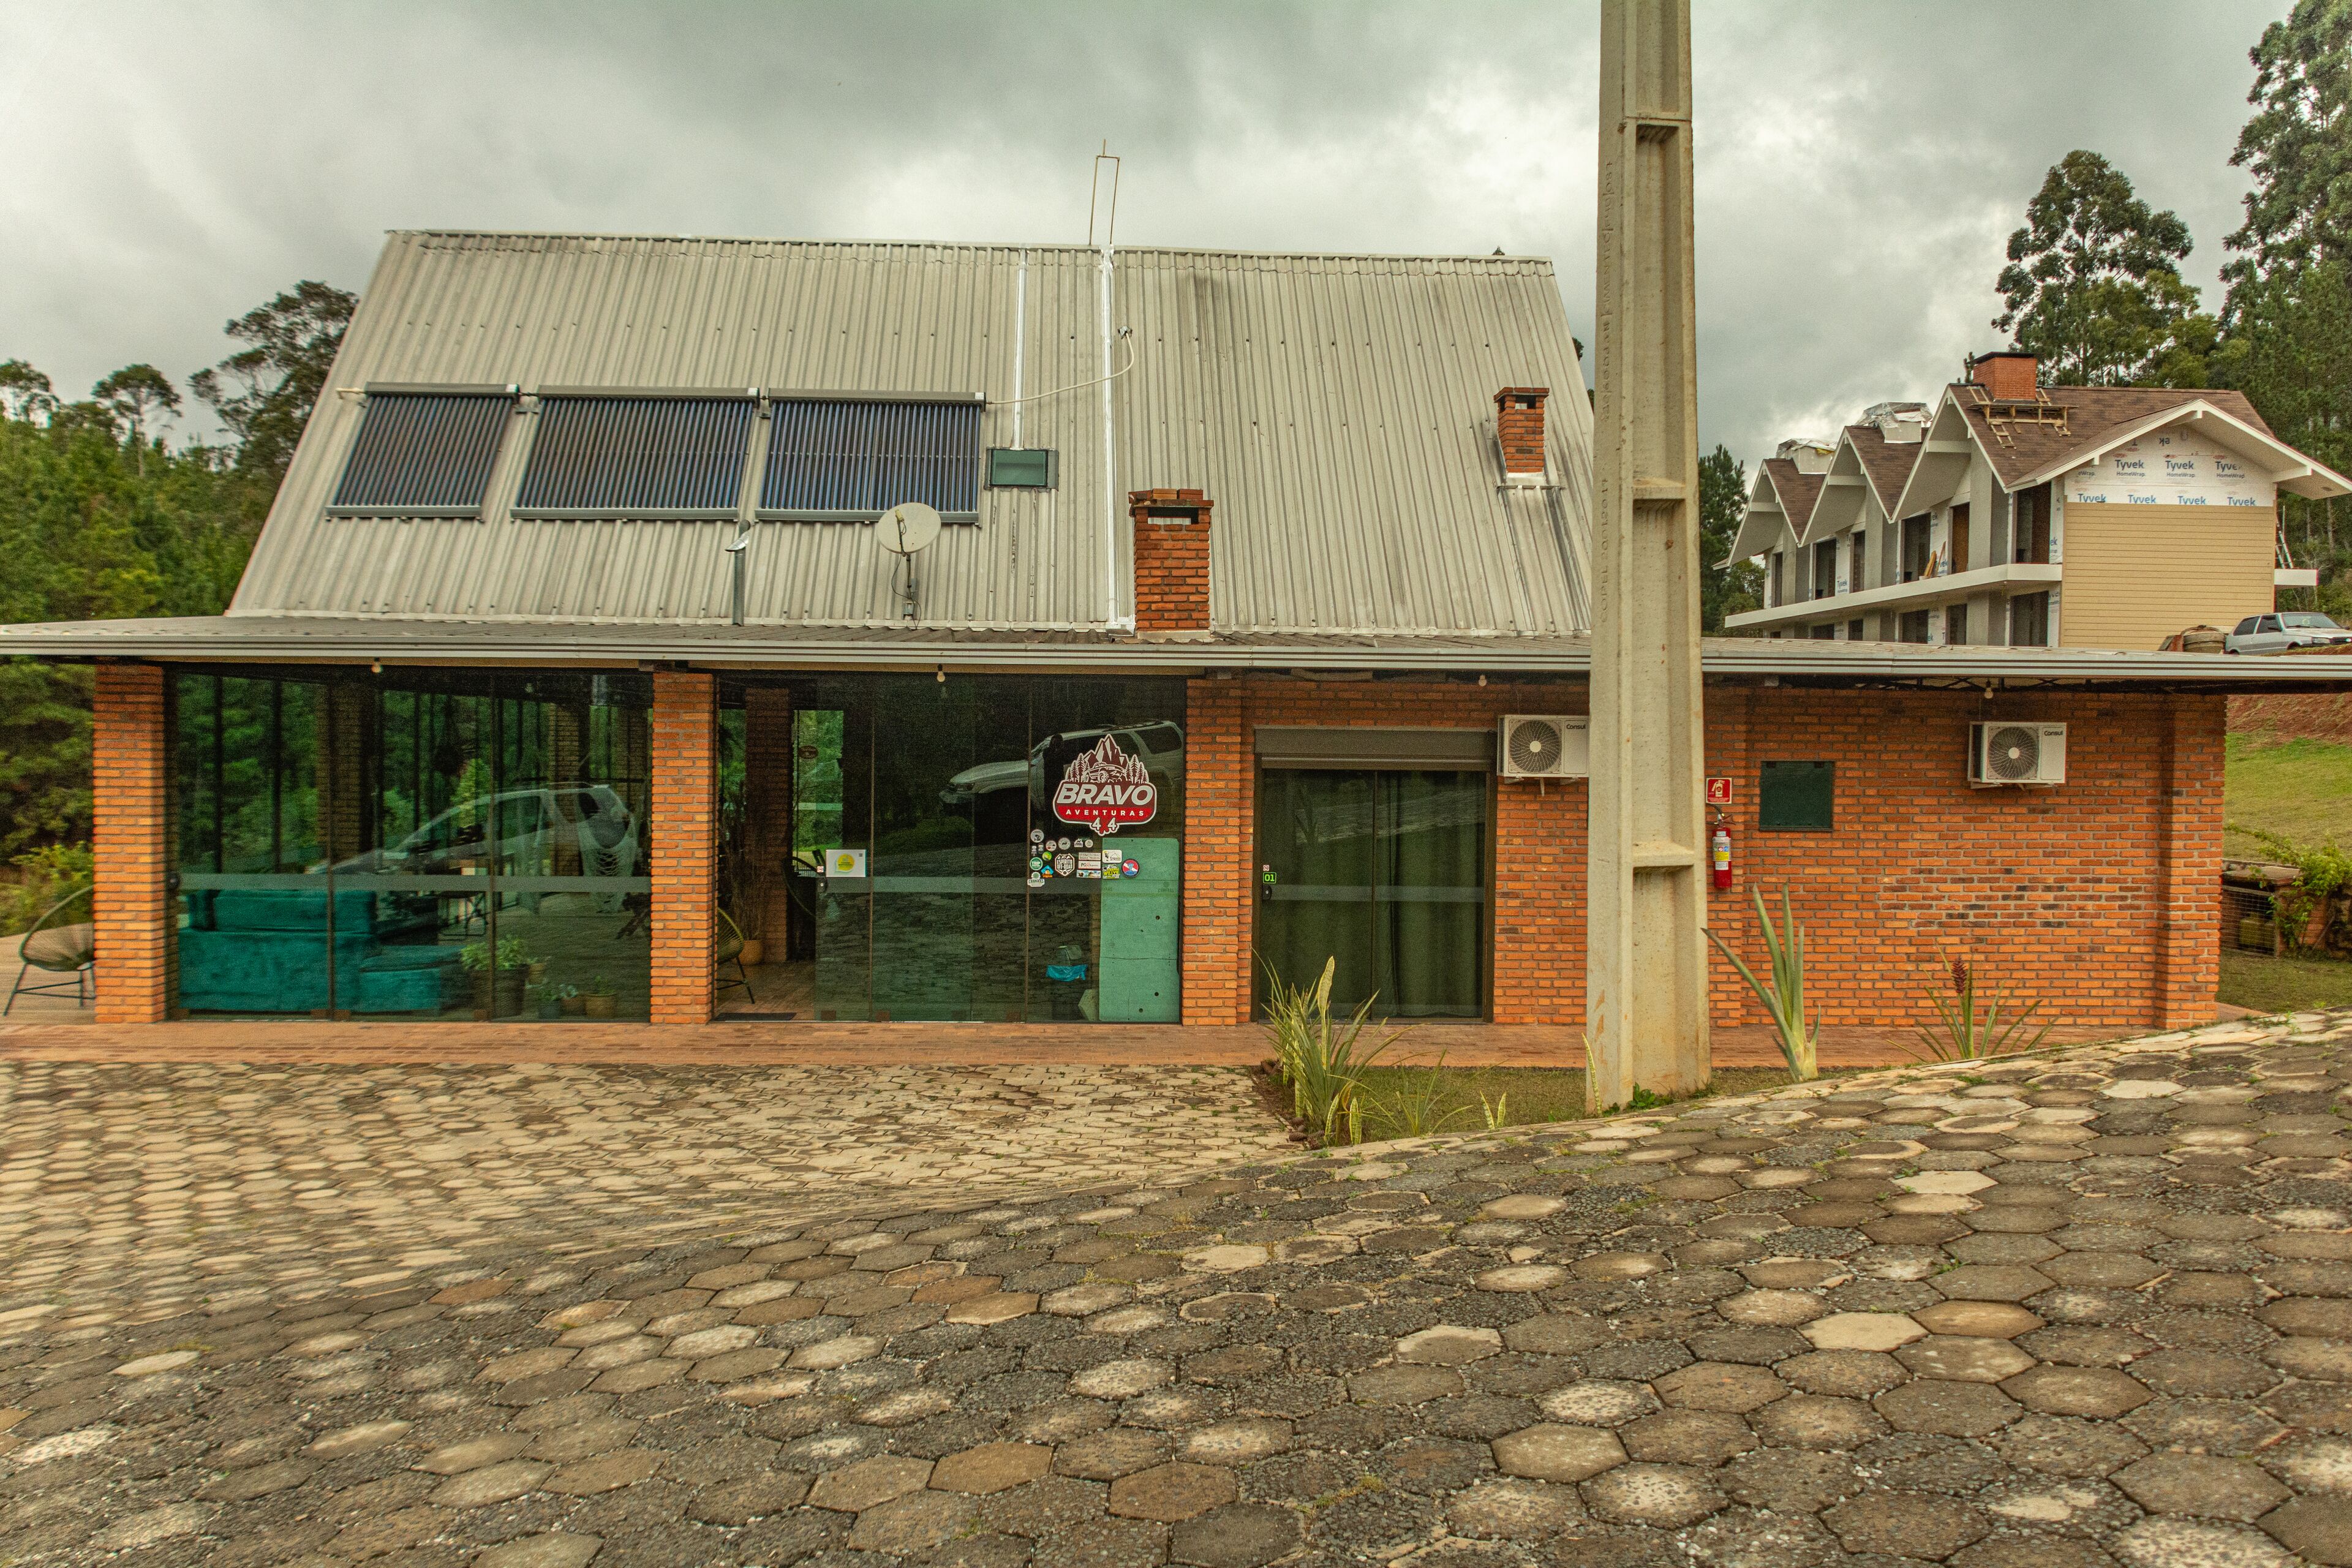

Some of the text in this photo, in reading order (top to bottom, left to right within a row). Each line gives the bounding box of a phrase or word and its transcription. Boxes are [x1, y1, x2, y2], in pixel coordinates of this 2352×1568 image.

[2115, 459, 2144, 470] Tyvek
[2165, 460, 2194, 471] Tyvek
[2215, 461, 2242, 472] Tyve
[2078, 494, 2106, 503] Tyvek
[2128, 494, 2156, 503] Tyvek
[2177, 496, 2206, 505] Tyvek
[2227, 497, 2255, 506] Tyvek
[1057, 784, 1153, 805] BRAVO
